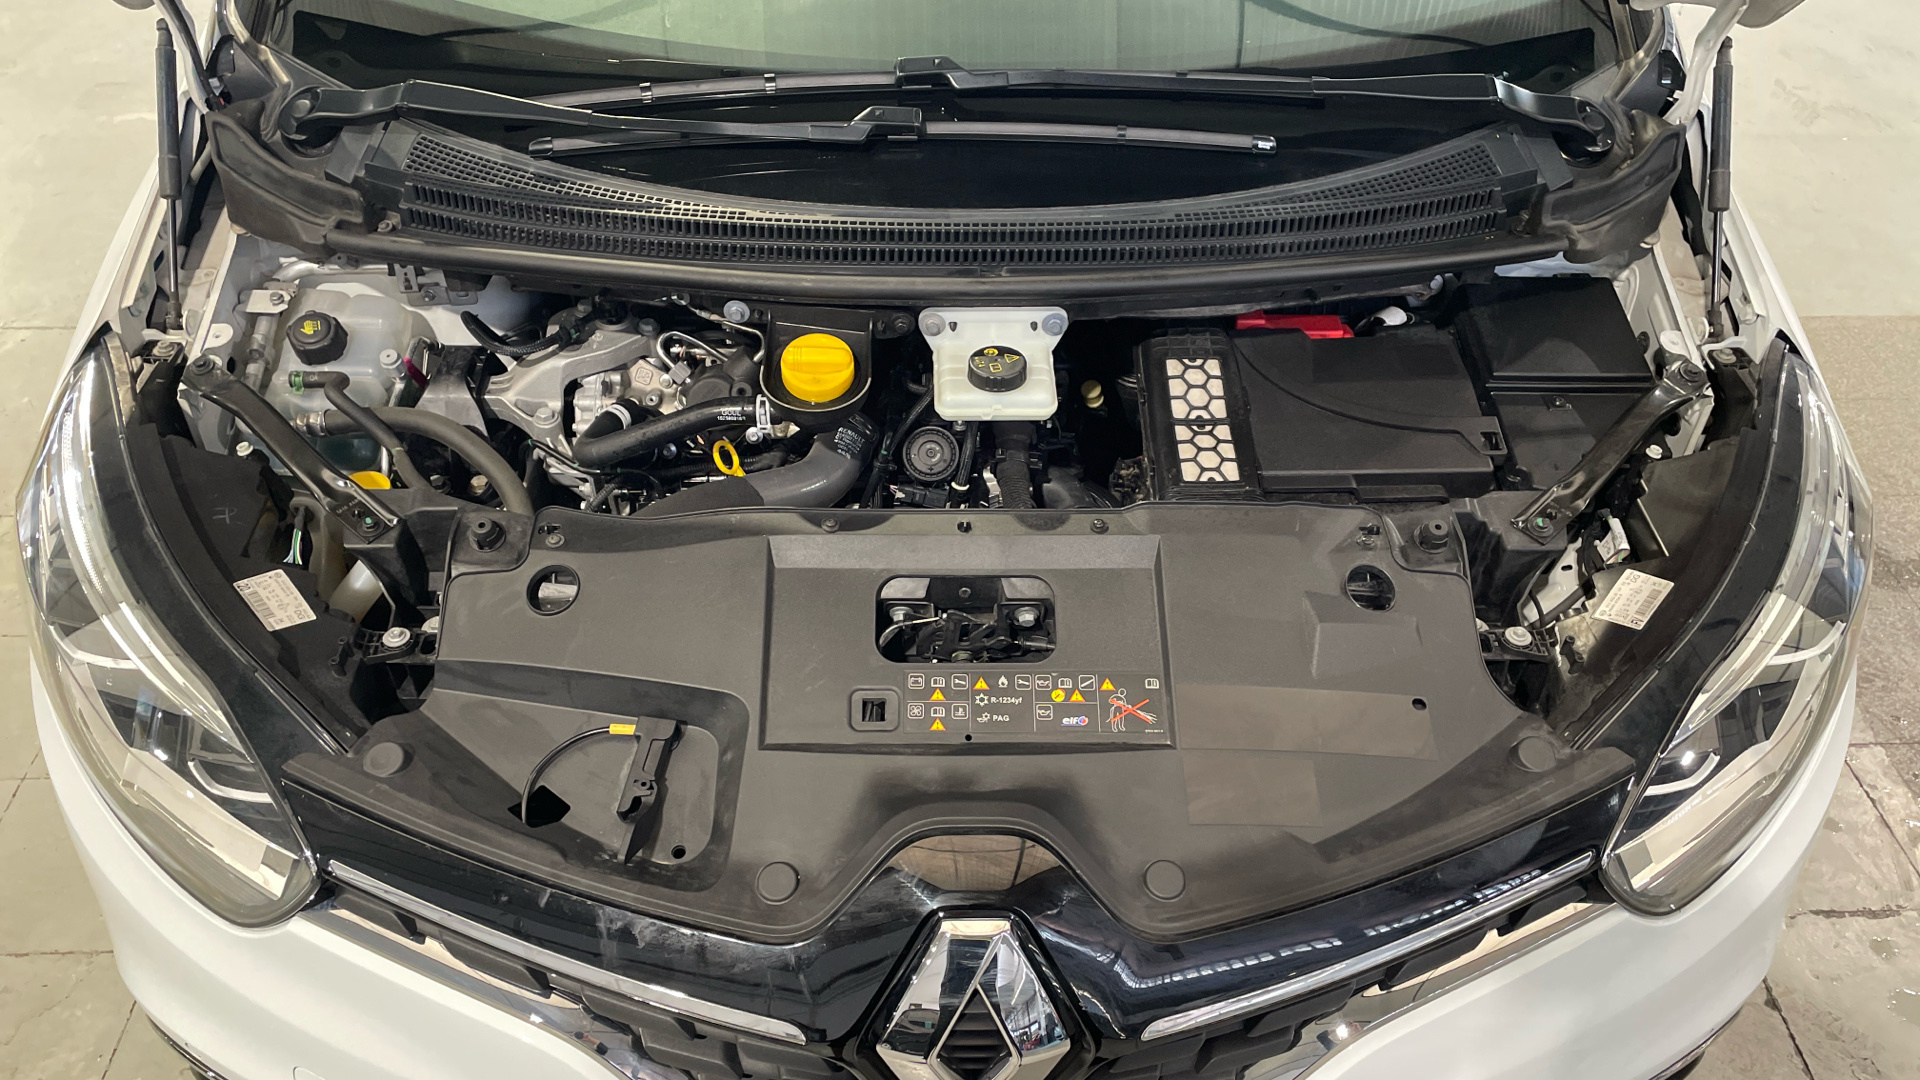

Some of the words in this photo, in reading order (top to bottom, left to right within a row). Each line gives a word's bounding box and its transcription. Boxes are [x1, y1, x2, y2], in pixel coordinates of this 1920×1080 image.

[837, 427, 865, 443] RENAULT
[294, 609, 306, 620] DG
[990, 696, 1023, 706] R-1234yf
[992, 714, 1010, 722] PAG
